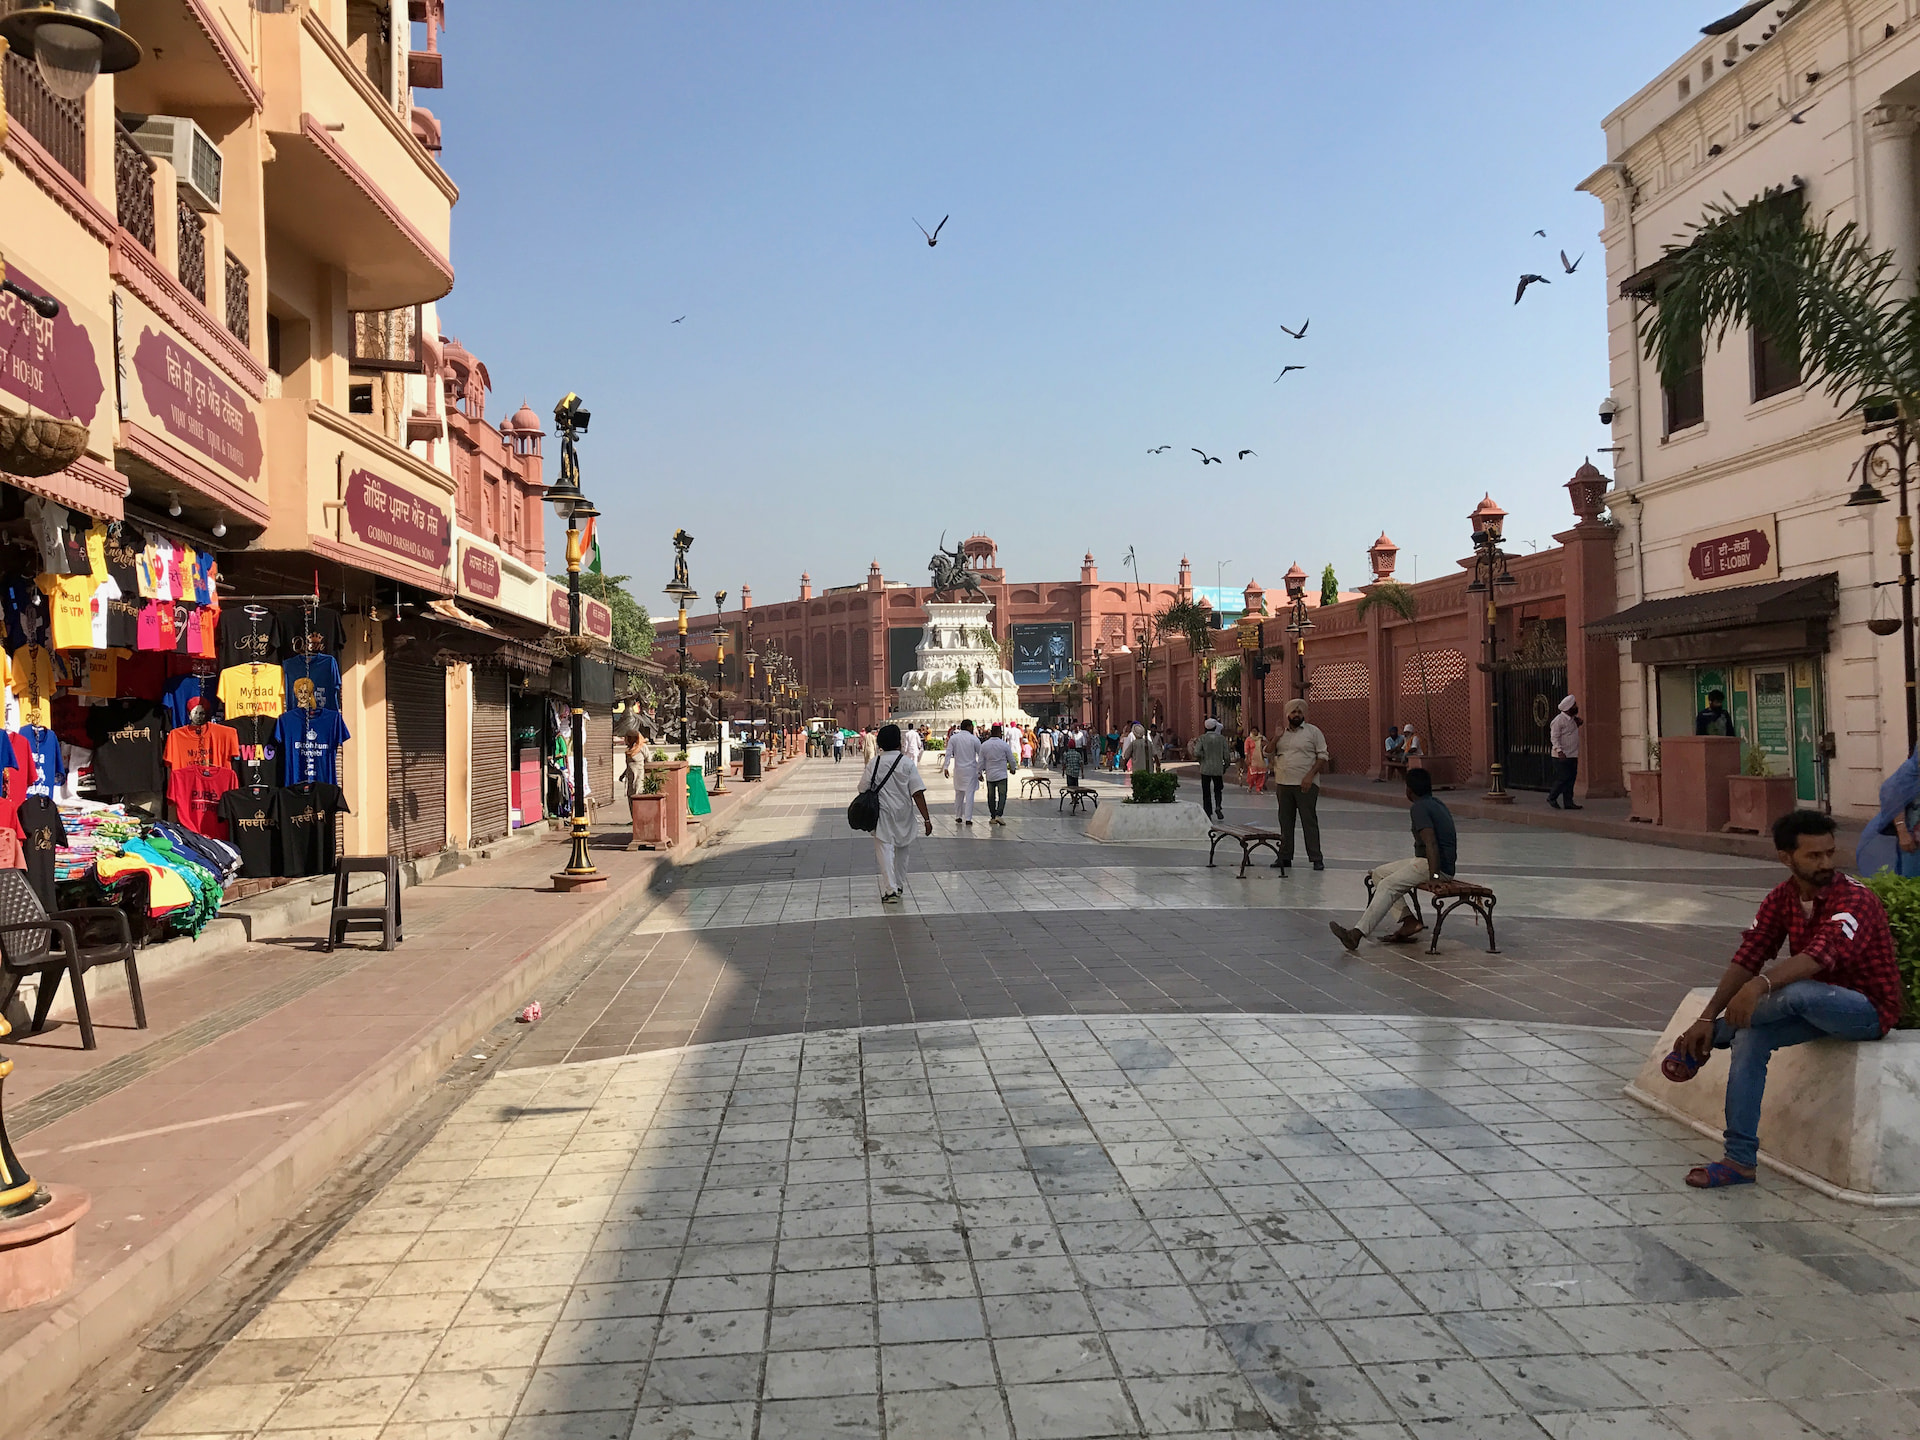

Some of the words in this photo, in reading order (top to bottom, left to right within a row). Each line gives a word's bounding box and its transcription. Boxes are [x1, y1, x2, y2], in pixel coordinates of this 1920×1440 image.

[12, 354, 44, 393] HOUSE
[171, 403, 186, 429] VIJAY
[188, 416, 205, 441] SHREE
[206, 428, 221, 452] TOUR
[221, 438, 227, 455] &
[227, 442, 244, 468] TRAVELS
[363, 474, 387, 513] ਗੋਬਿੰਦ
[367, 525, 393, 545] GOBIND
[393, 534, 417, 554] PARSHAD
[416, 544, 421, 557] &
[421, 545, 435, 562] SONS
[1719, 553, 1751, 571] E-LOBBY
[240, 687, 252, 698] My
[254, 686, 274, 697] dad
[1758, 695, 1785, 705] E-LOBBY
[236, 702, 244, 710] is
[256, 701, 277, 712] ATM
[234, 744, 276, 761] WAG
